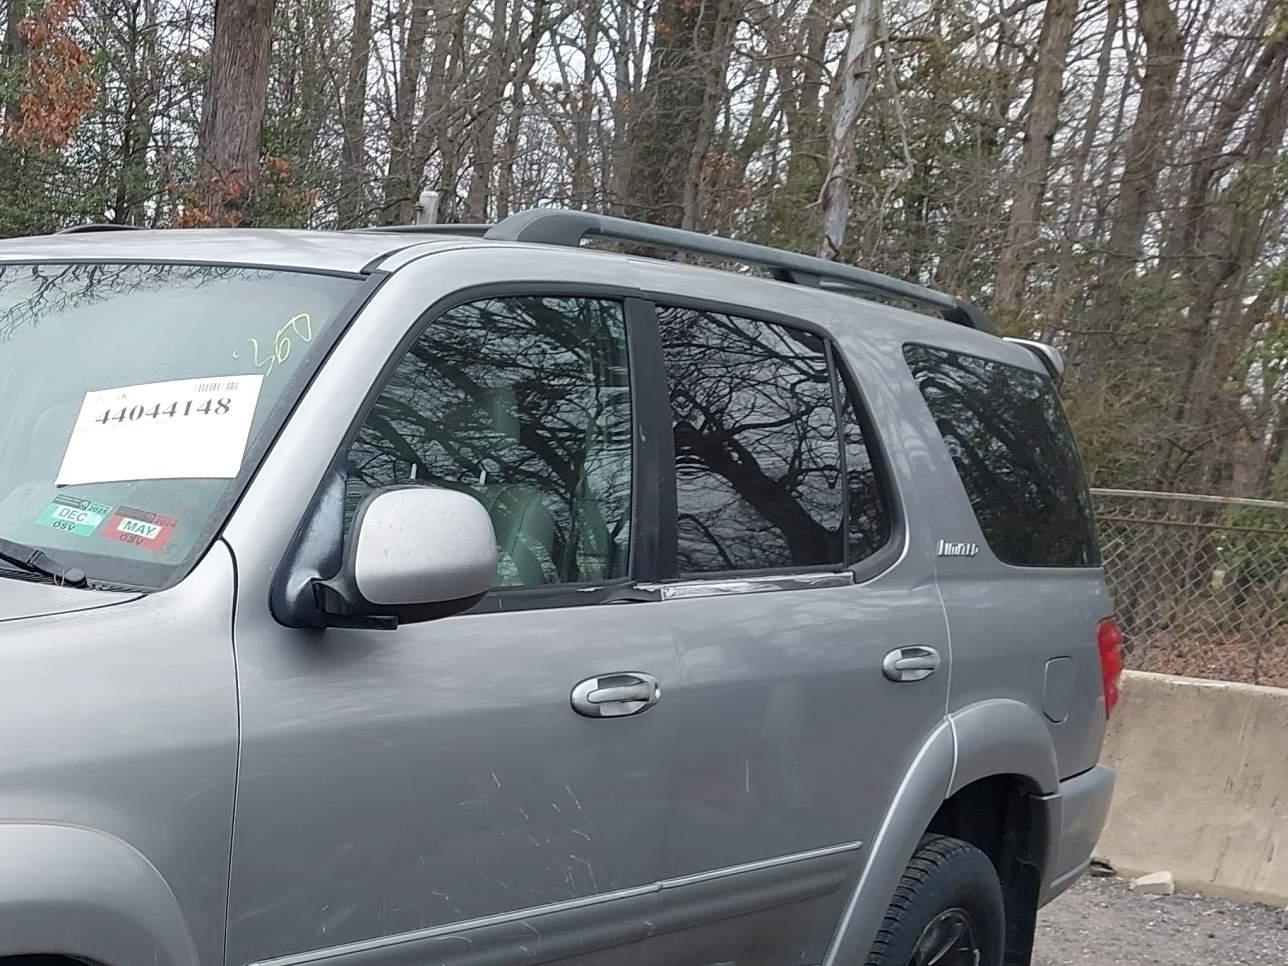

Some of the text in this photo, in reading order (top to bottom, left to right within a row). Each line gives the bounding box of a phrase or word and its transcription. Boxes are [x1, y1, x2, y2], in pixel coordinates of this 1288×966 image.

[95, 398, 232, 425] 44044148
[58, 507, 88, 522] DEC
[88, 505, 109, 515] 2025
[123, 520, 157, 535] MAY
